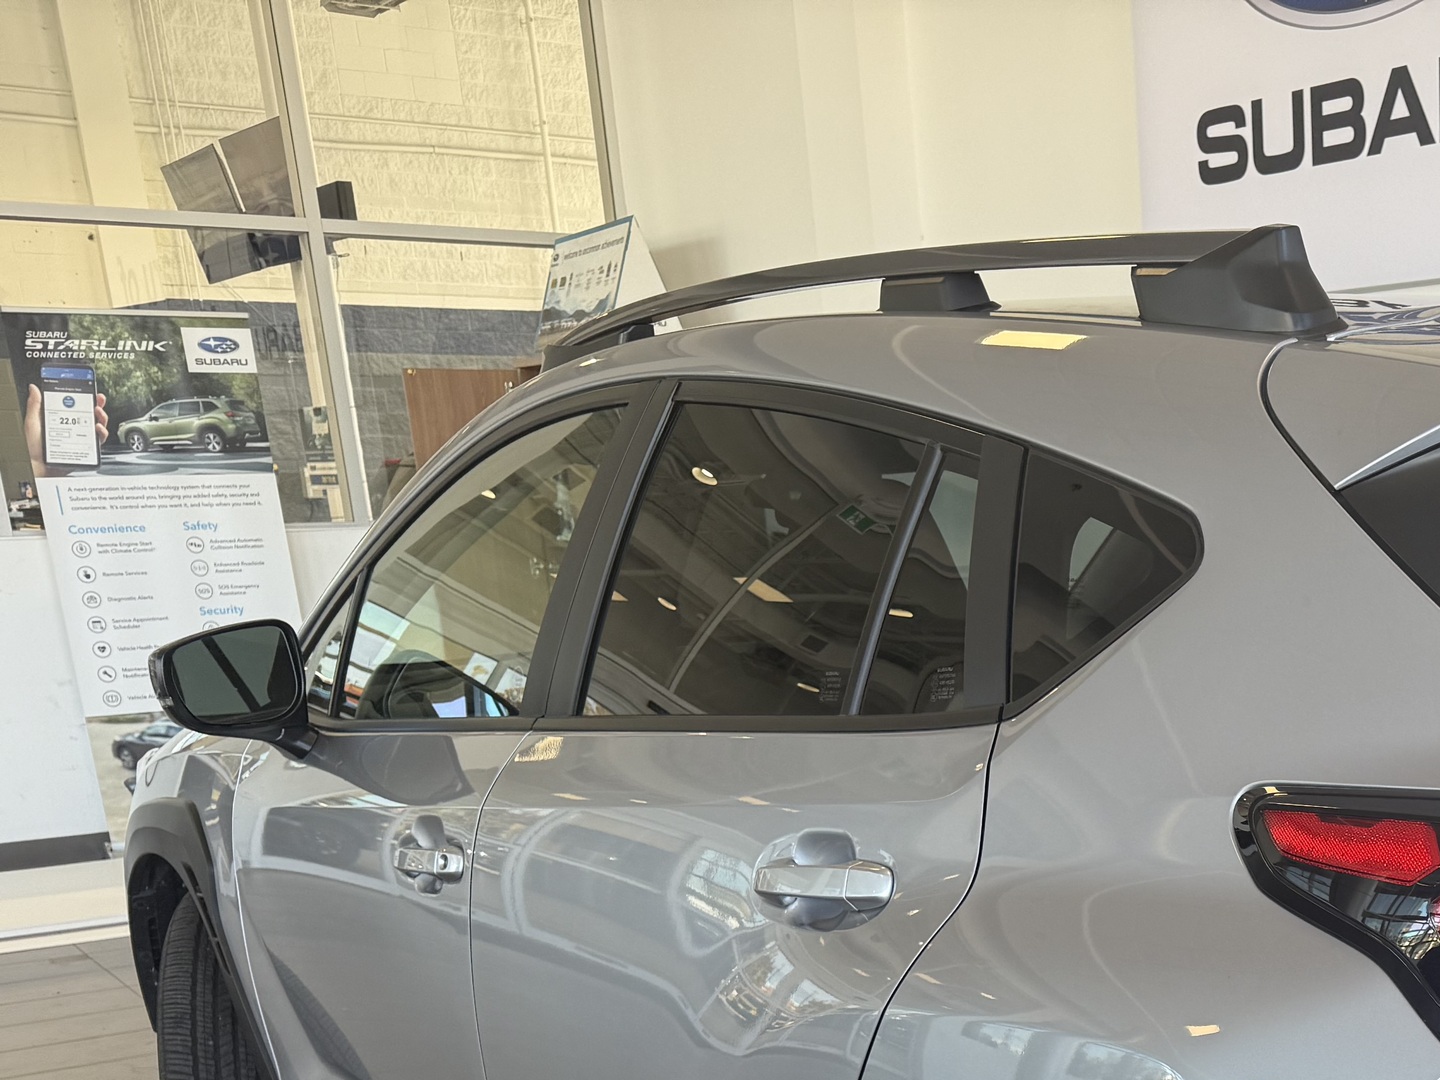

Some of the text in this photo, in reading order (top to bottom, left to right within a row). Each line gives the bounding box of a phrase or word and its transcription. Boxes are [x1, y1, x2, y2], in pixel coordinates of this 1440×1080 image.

[25, 330, 68, 338] SUBARU
[24, 338, 168, 352] STARLINK
[26, 351, 86, 359] CONNECTED
[195, 358, 248, 366] SUBARU
[60, 416, 77, 426] 22.0
[68, 524, 146, 535] Convenience
[182, 520, 218, 532] Safety
[199, 605, 244, 616] Security
